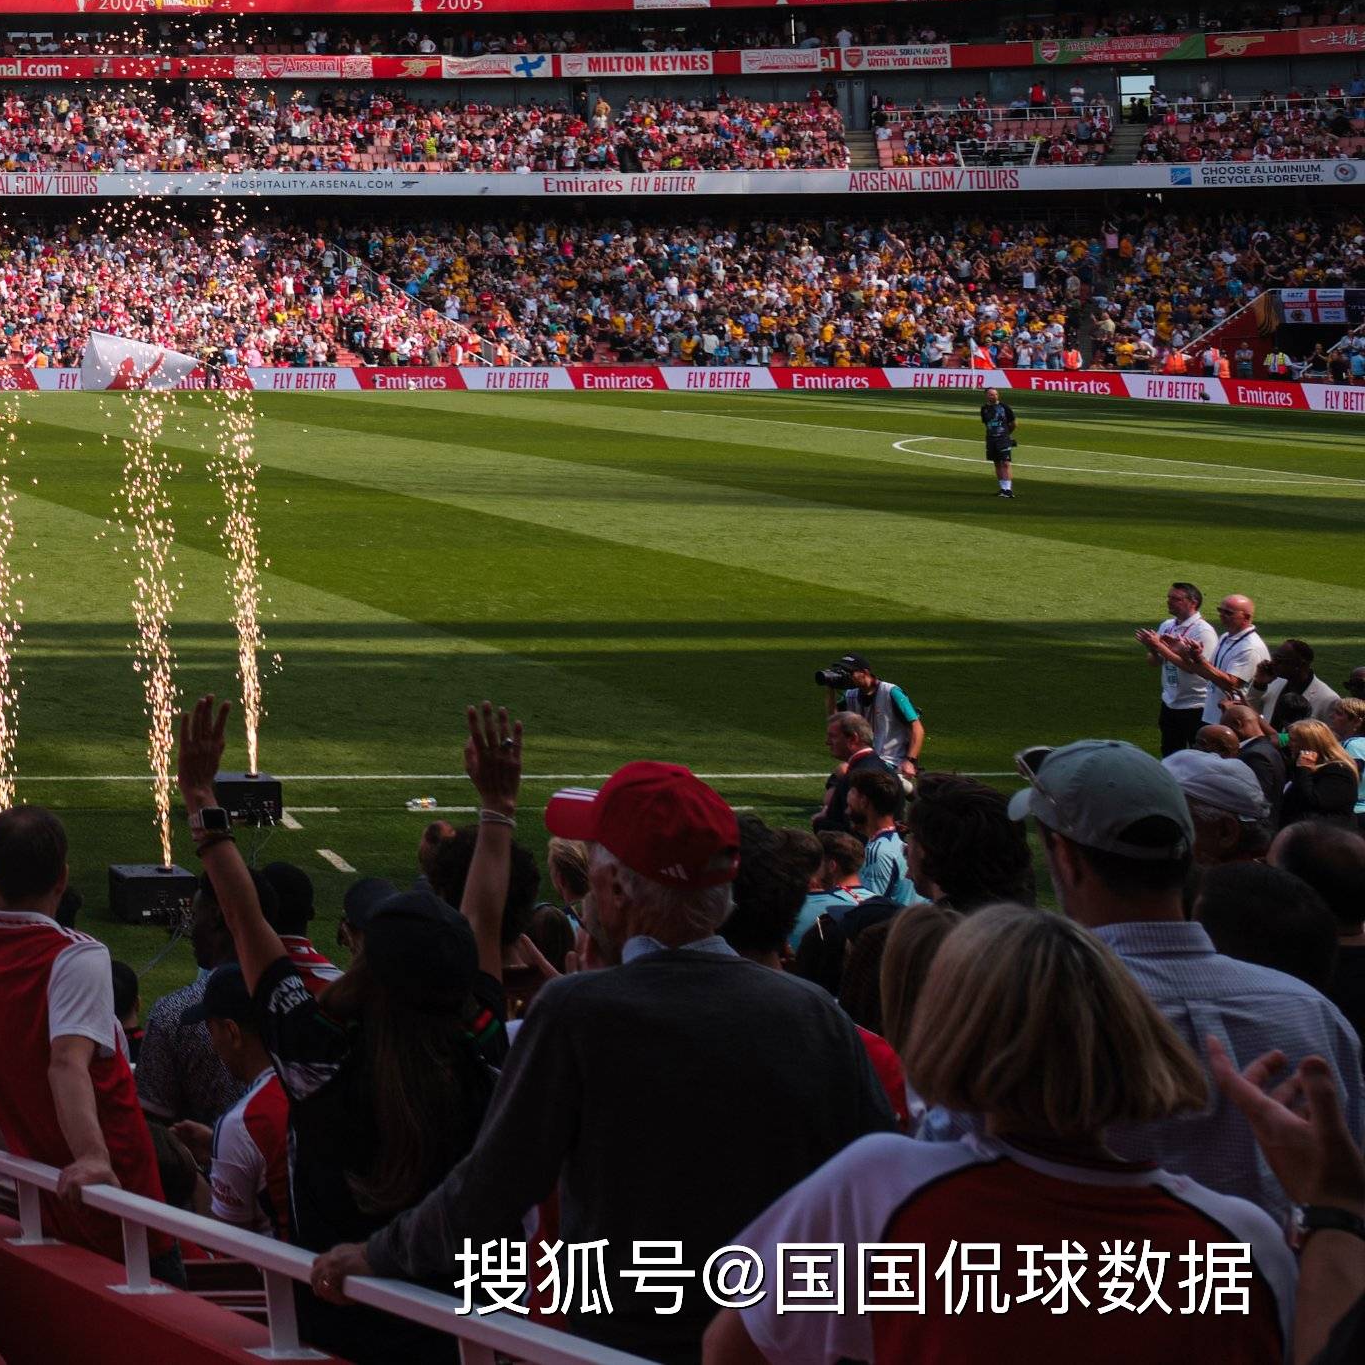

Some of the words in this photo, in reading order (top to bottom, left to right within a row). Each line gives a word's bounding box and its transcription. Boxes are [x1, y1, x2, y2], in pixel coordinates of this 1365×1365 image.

[285, 57, 340, 72] Arsenal
[588, 57, 644, 74] MILTON
[650, 54, 709, 72] KEYNES
[867, 58, 890, 67] WITH
[893, 57, 910, 66] YOU
[912, 56, 948, 66] ALWAYS
[1201, 166, 1250, 175] CHOOSE
[1254, 164, 1325, 174] ALUMINIUM.
[231, 180, 393, 189] HOSPITALITY.ARSENAL.COM
[544, 176, 623, 193] Emirates
[631, 177, 649, 193] FLY
[653, 177, 695, 192] BETTER
[849, 169, 1019, 192] ARSENAL.COM/TOURS
[1203, 175, 1263, 184] RECYCLES
[1267, 174, 1324, 183] FOREVER.
[59, 374, 77, 389] FLY
[274, 373, 291, 389] FLY
[294, 373, 335, 389] BETTER
[375, 374, 446, 390] Emirates
[486, 373, 505, 389] FLY
[508, 373, 548, 389] BETTER
[583, 374, 653, 390] Emirates
[687, 373, 705, 389] FLY
[708, 373, 750, 389] BETTER
[793, 373, 869, 389] Emirates
[914, 374, 935, 388] FLY
[938, 374, 984, 389] BETTER
[1031, 377, 1110, 395] Emirates
[1147, 380, 1166, 398] FLY
[1167, 381, 1205, 400] BETTER
[1238, 386, 1293, 407] Emirates
[1324, 390, 1342, 410] FLY
[1343, 391, 1365, 412] BETT
